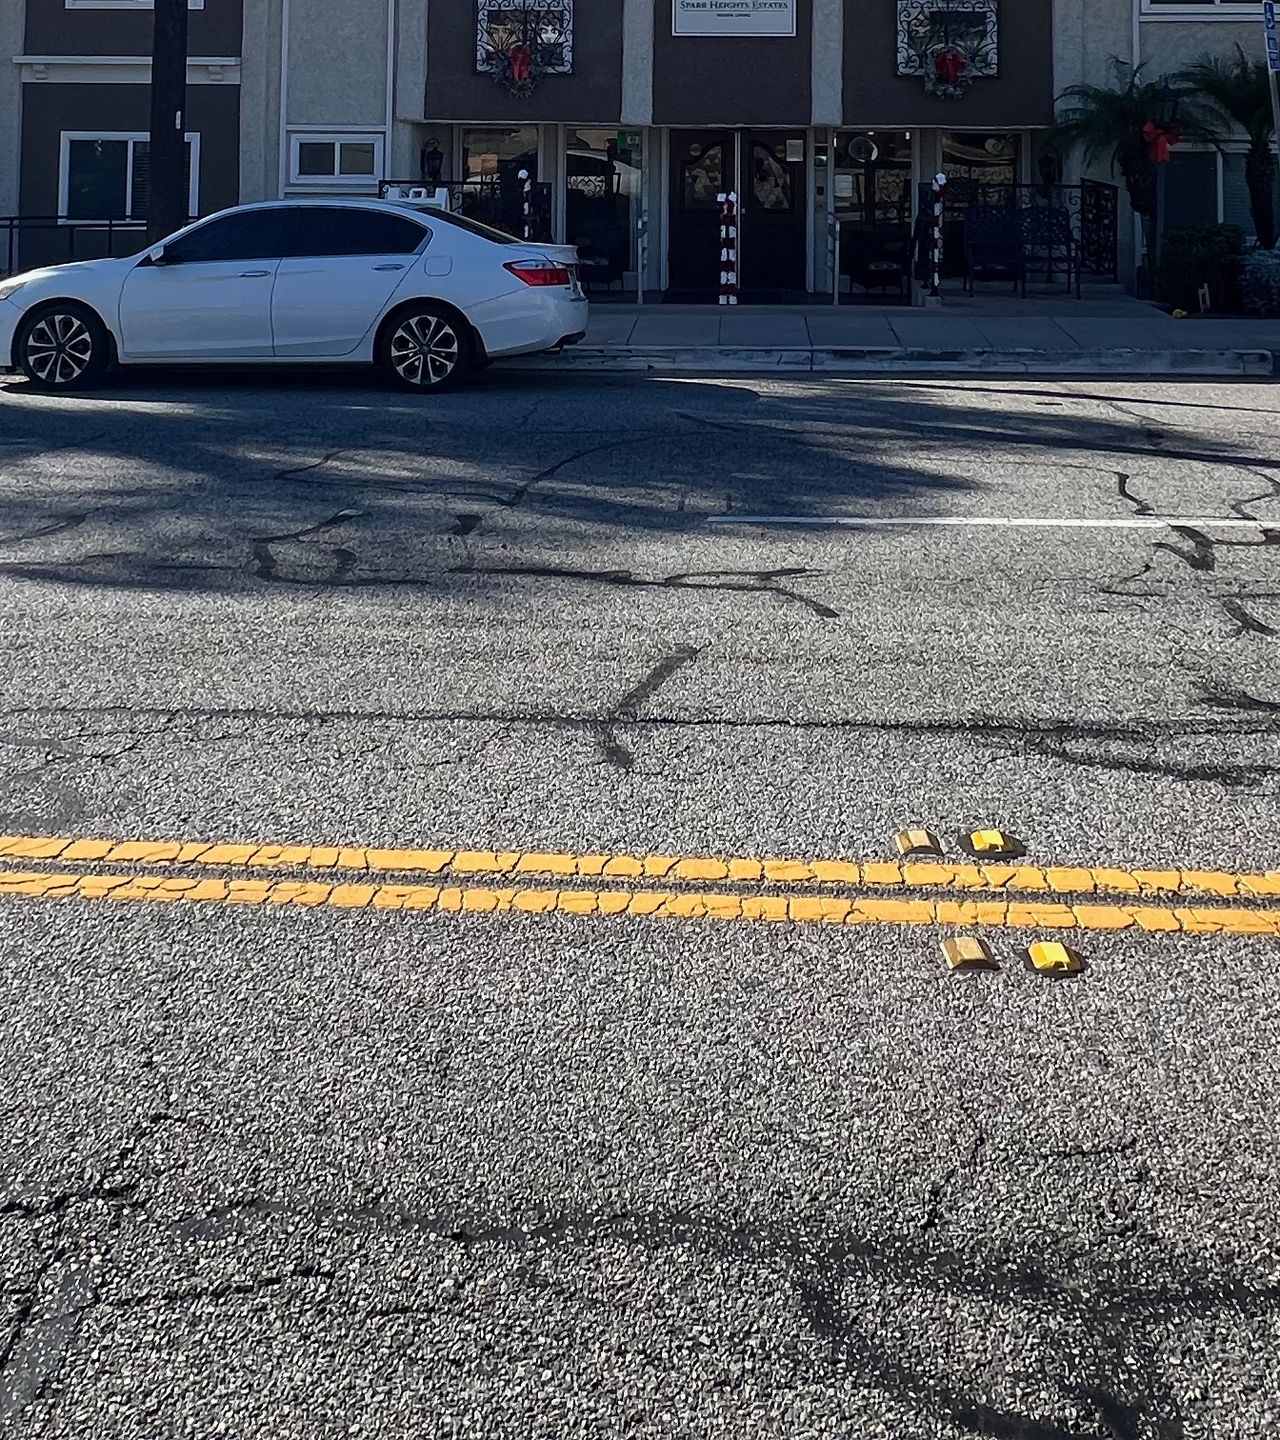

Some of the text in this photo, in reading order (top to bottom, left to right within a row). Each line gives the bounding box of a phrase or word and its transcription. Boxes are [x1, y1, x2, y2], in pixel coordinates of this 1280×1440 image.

[680, 0, 788, 9] SPARR HEIGHTS ESTATES
